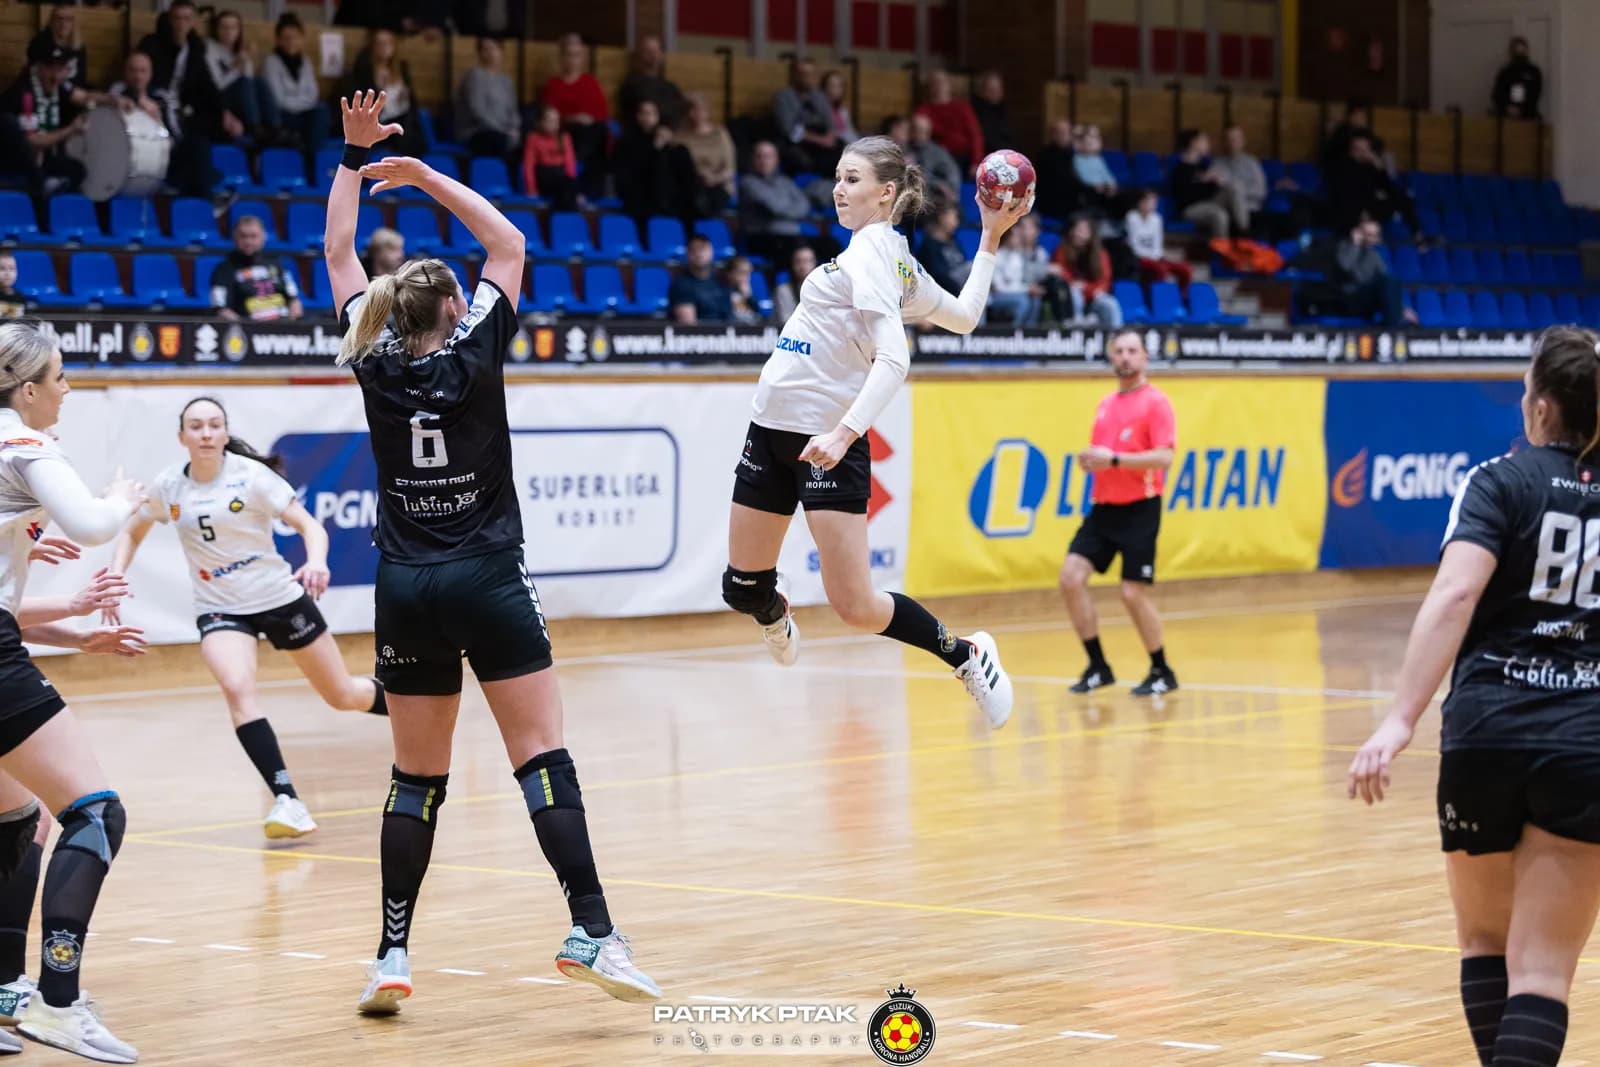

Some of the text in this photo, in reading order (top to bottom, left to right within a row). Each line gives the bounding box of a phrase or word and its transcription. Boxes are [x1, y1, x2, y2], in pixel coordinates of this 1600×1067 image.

[776, 337, 811, 356] UZUKI
[409, 410, 449, 468] 6
[528, 473, 660, 501] SUPERLIGA
[1371, 452, 1469, 501] PGNiG
[314, 488, 378, 529] PGN
[556, 508, 636, 527] KOBIET
[198, 514, 217, 542] 5
